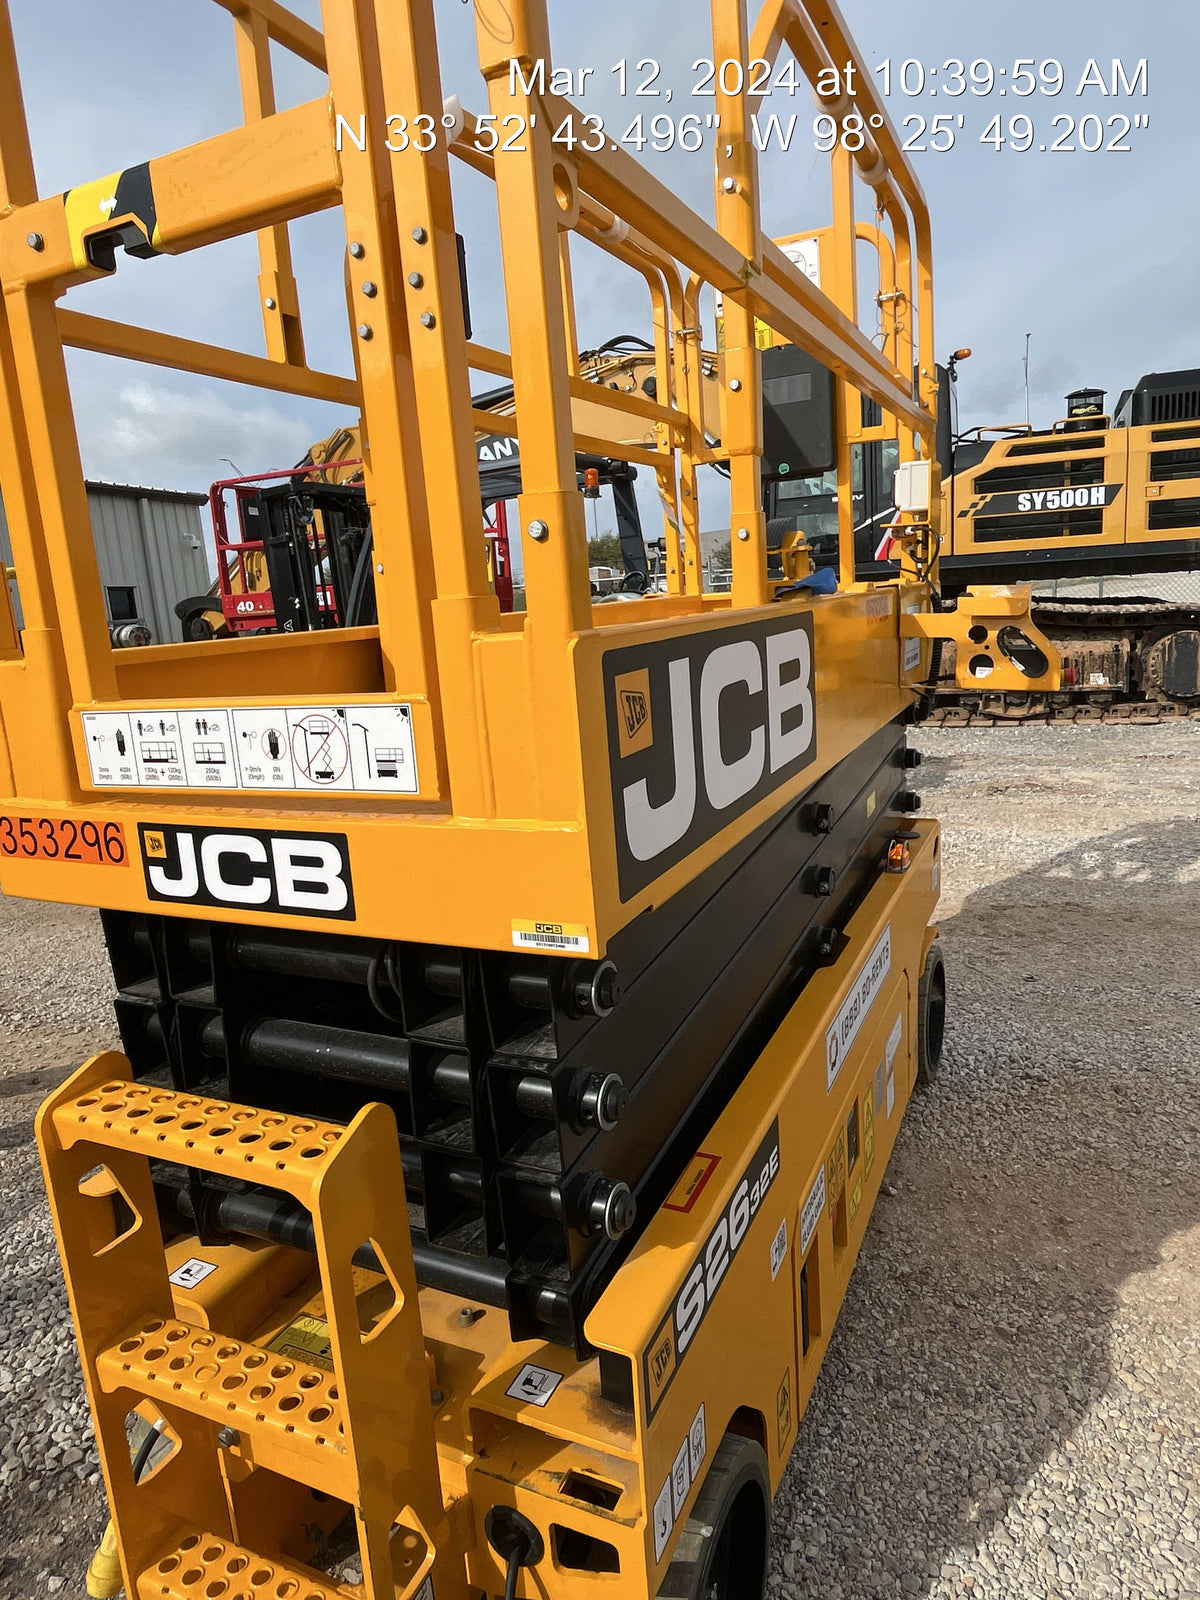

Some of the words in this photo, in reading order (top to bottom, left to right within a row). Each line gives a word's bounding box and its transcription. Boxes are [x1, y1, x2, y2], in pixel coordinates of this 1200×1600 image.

[1017, 486, 1106, 512] SY500H
[236, 601, 254, 612] 40
[625, 694, 647, 732] JCB
[622, 628, 814, 862] JCB
[0, 816, 125, 863] 353296
[148, 832, 349, 912] JCB
[536, 924, 562, 934] JCB
[654, 1340, 672, 1382] JCB
